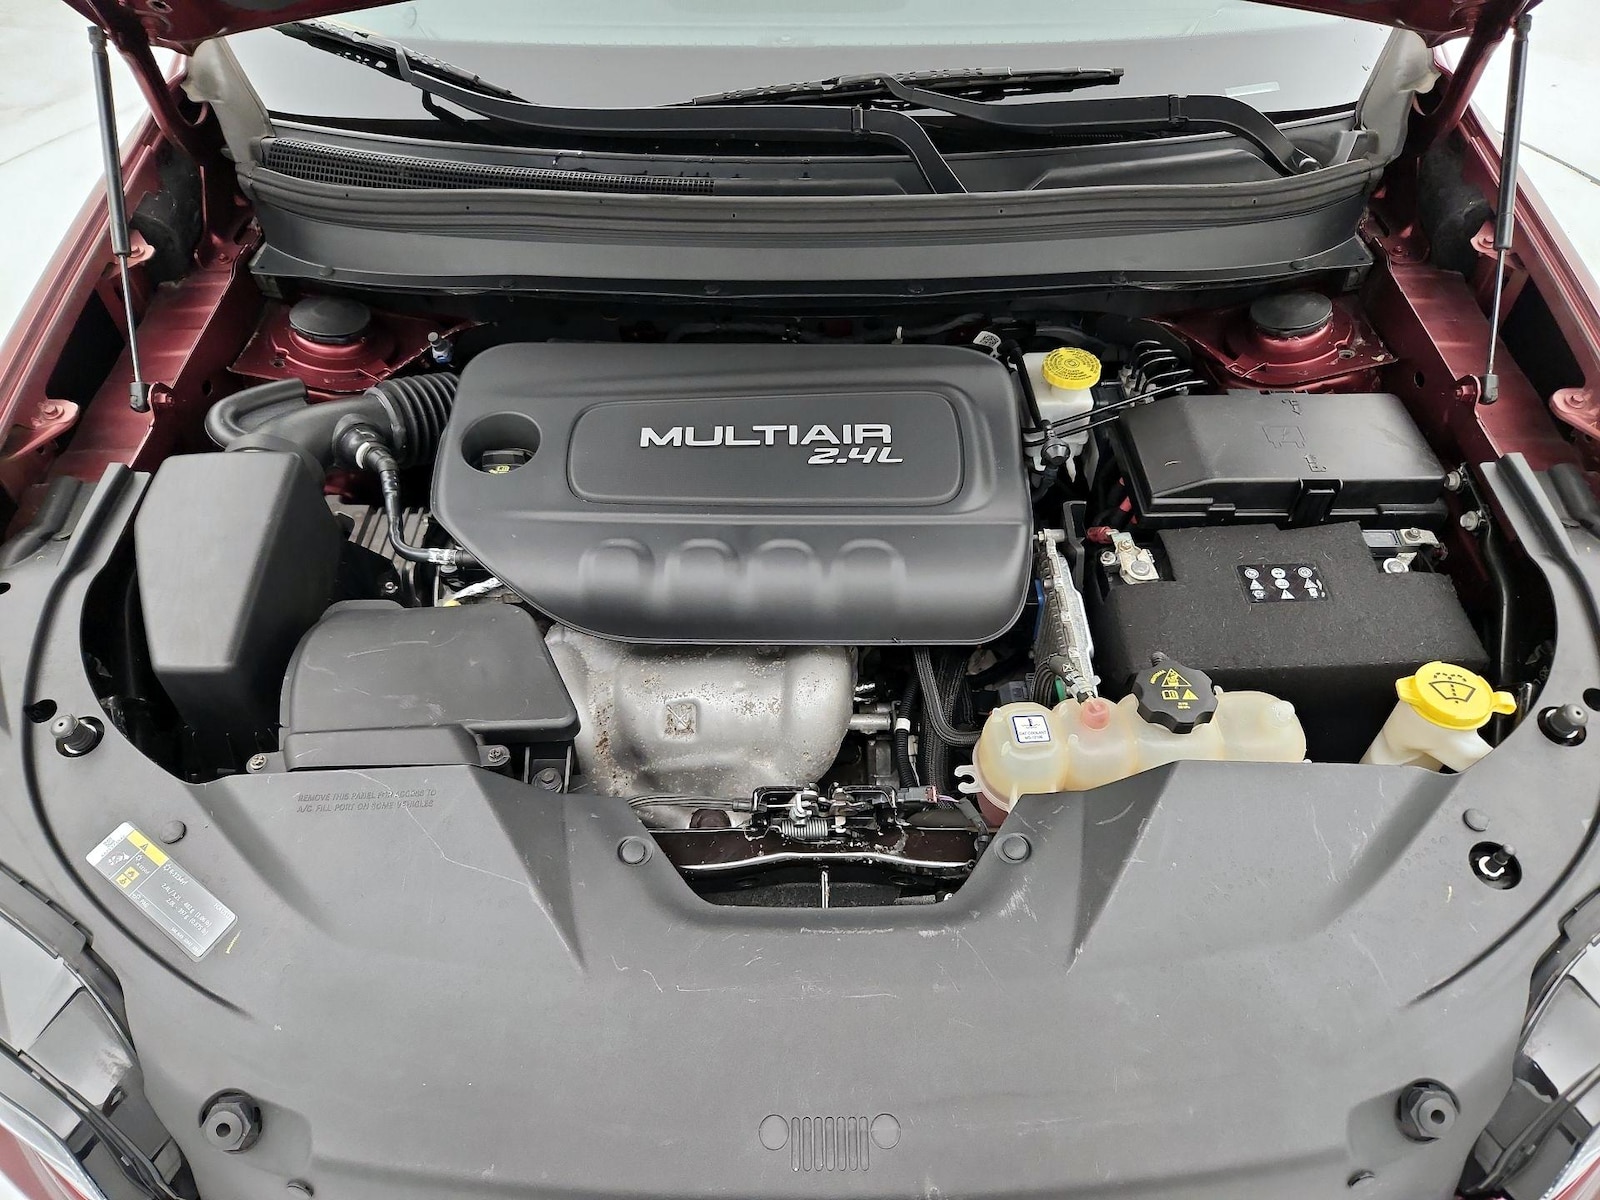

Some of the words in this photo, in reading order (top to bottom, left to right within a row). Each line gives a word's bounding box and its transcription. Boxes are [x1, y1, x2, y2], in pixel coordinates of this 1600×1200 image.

[640, 424, 892, 448] MULTIAIR
[807, 446, 904, 465] 2.4L
[298, 793, 330, 802] REMOVE
[332, 793, 349, 801] THIS
[351, 792, 376, 800] PANEL
[297, 805, 312, 813] A/C
[315, 804, 331, 812] FILL
[334, 803, 354, 811] PORT
[357, 802, 369, 810] ON
[397, 800, 434, 809] VEHICLES
